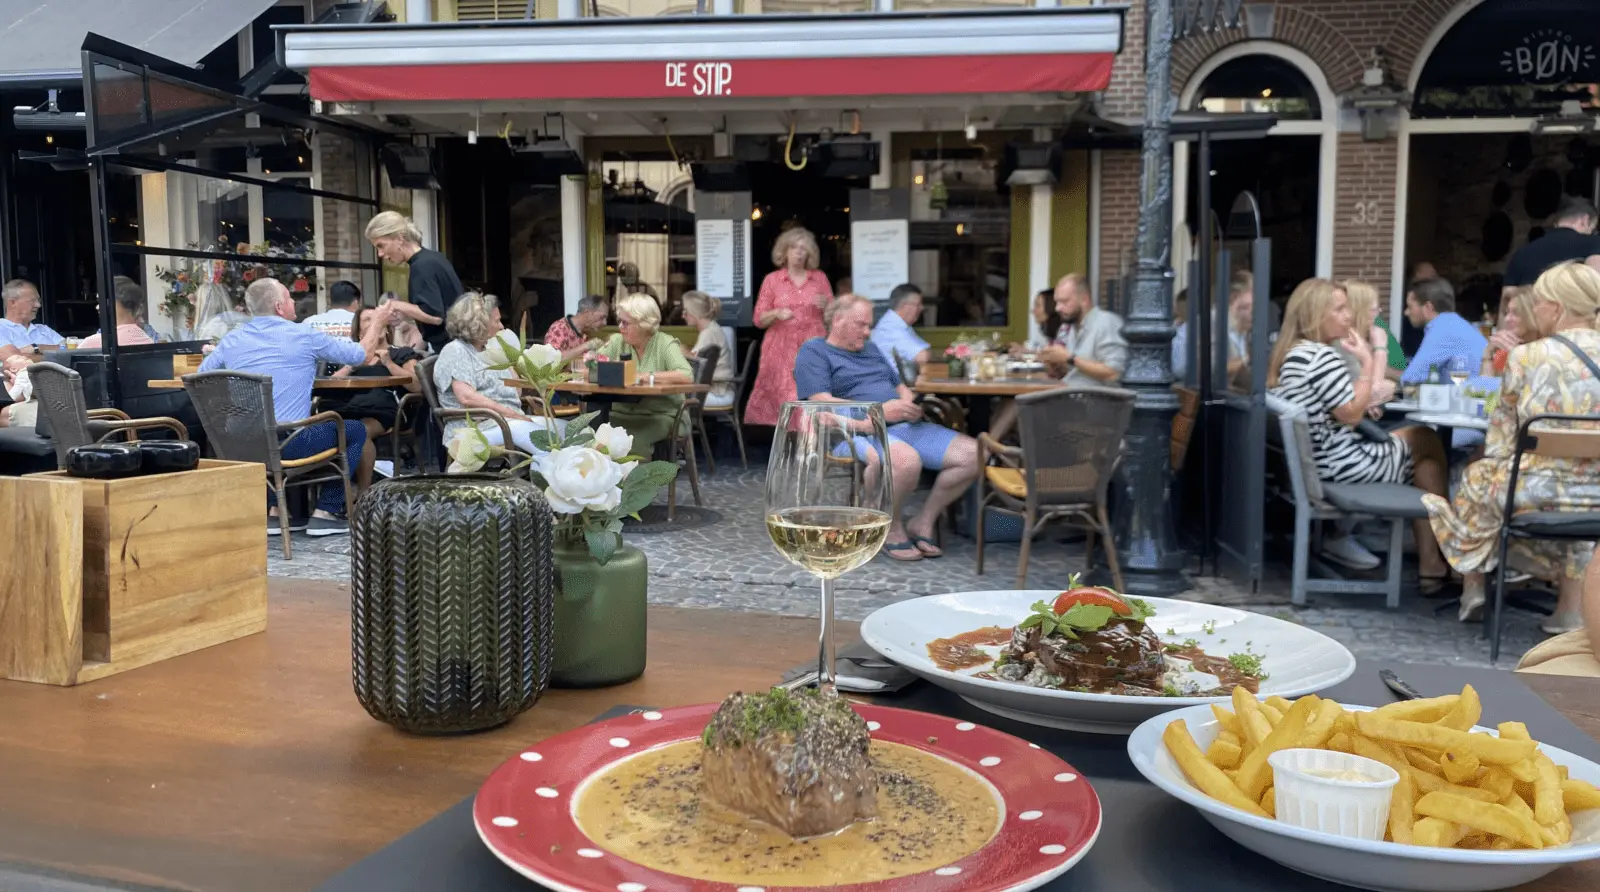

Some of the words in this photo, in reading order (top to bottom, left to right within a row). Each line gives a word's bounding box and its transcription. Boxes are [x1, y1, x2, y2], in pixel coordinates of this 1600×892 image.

[1515, 40, 1580, 80] BØN
[665, 62, 687, 87] DE
[693, 62, 732, 96] STIP.
